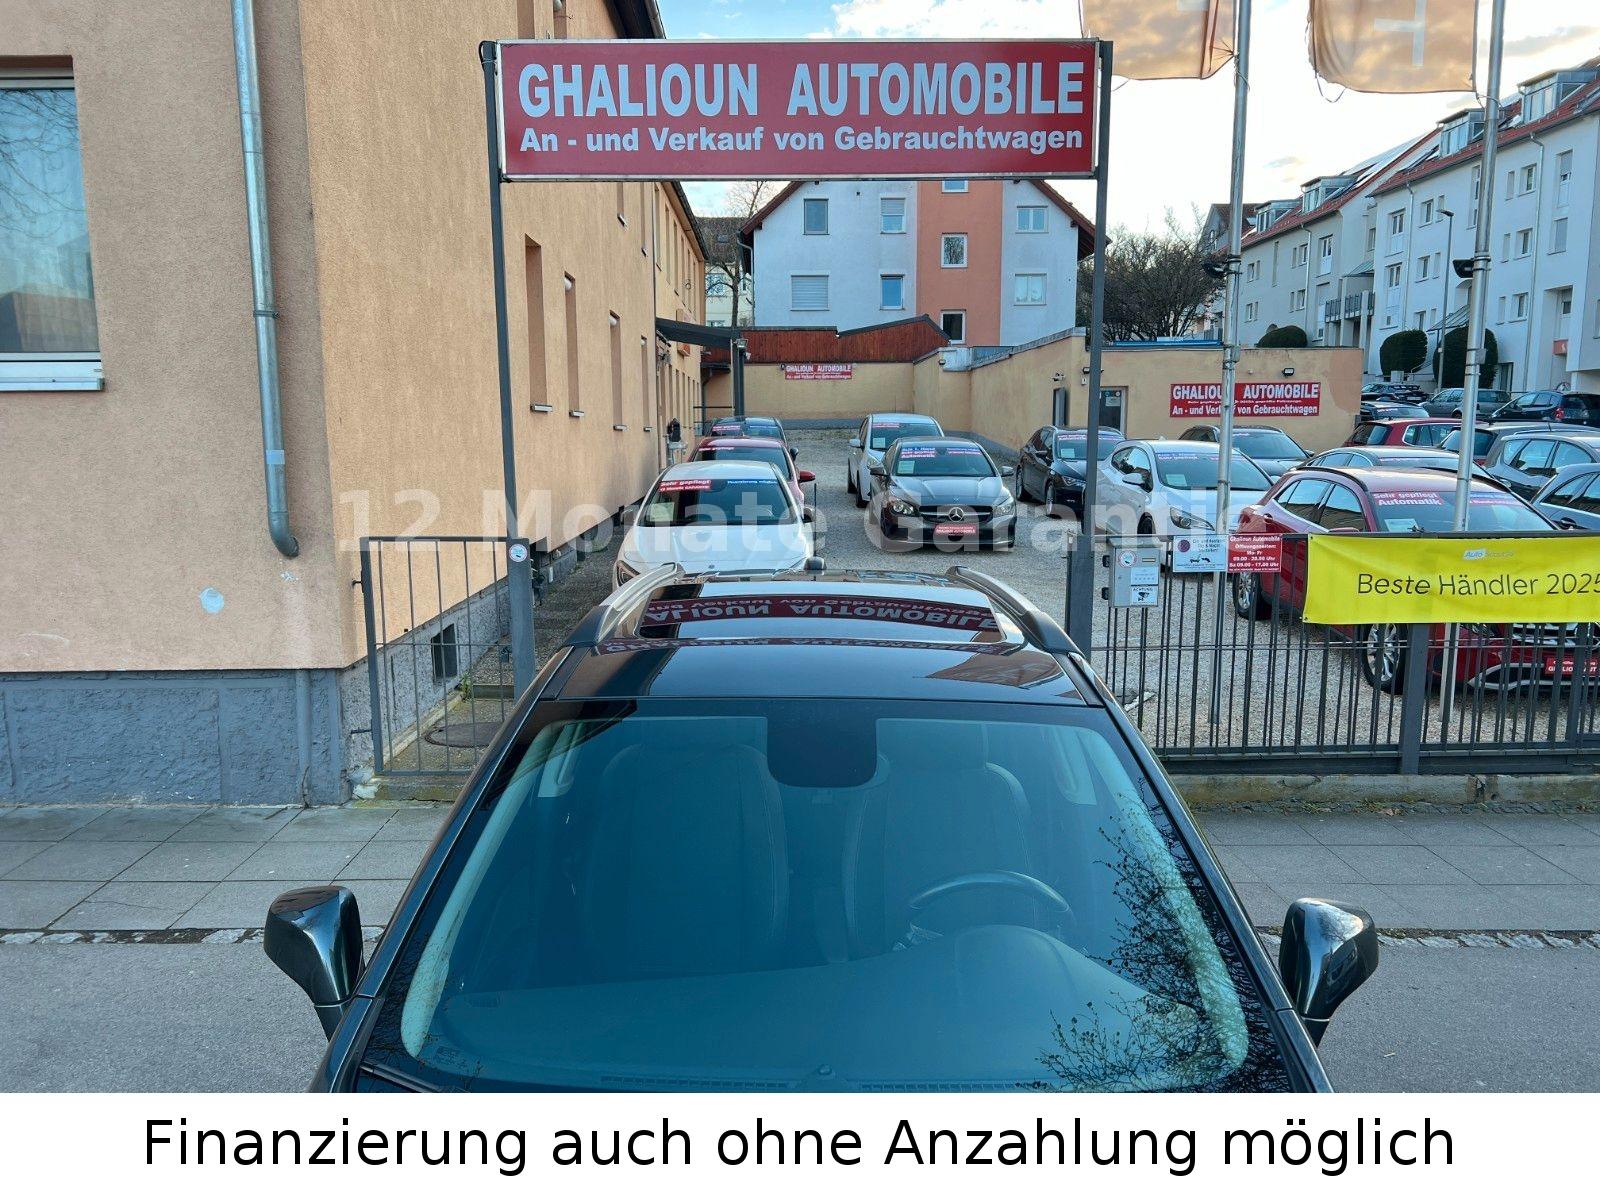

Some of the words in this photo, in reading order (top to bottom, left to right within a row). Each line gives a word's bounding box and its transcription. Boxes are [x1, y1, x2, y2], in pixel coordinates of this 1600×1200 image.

[518, 62, 758, 118] GHALIOUN
[786, 61, 1084, 117] AUTOMOBILE
[519, 127, 559, 152] An
[586, 127, 640, 152] und
[648, 126, 765, 152] Verkauf
[773, 132, 825, 151] von
[834, 125, 1083, 155] Gebrauchtwagen
[1172, 385, 1222, 400] GHALIOU
[1243, 383, 1319, 400] AUTOMOBILE
[1172, 405, 1184, 415] An
[1189, 405, 1204, 415] und
[1237, 406, 1252, 414] von
[1253, 404, 1318, 416] Gebrauchtwagen
[1378, 498, 1442, 506] Automatik
[1357, 573, 1431, 595] Beste
[1438, 573, 1539, 596] Händler
